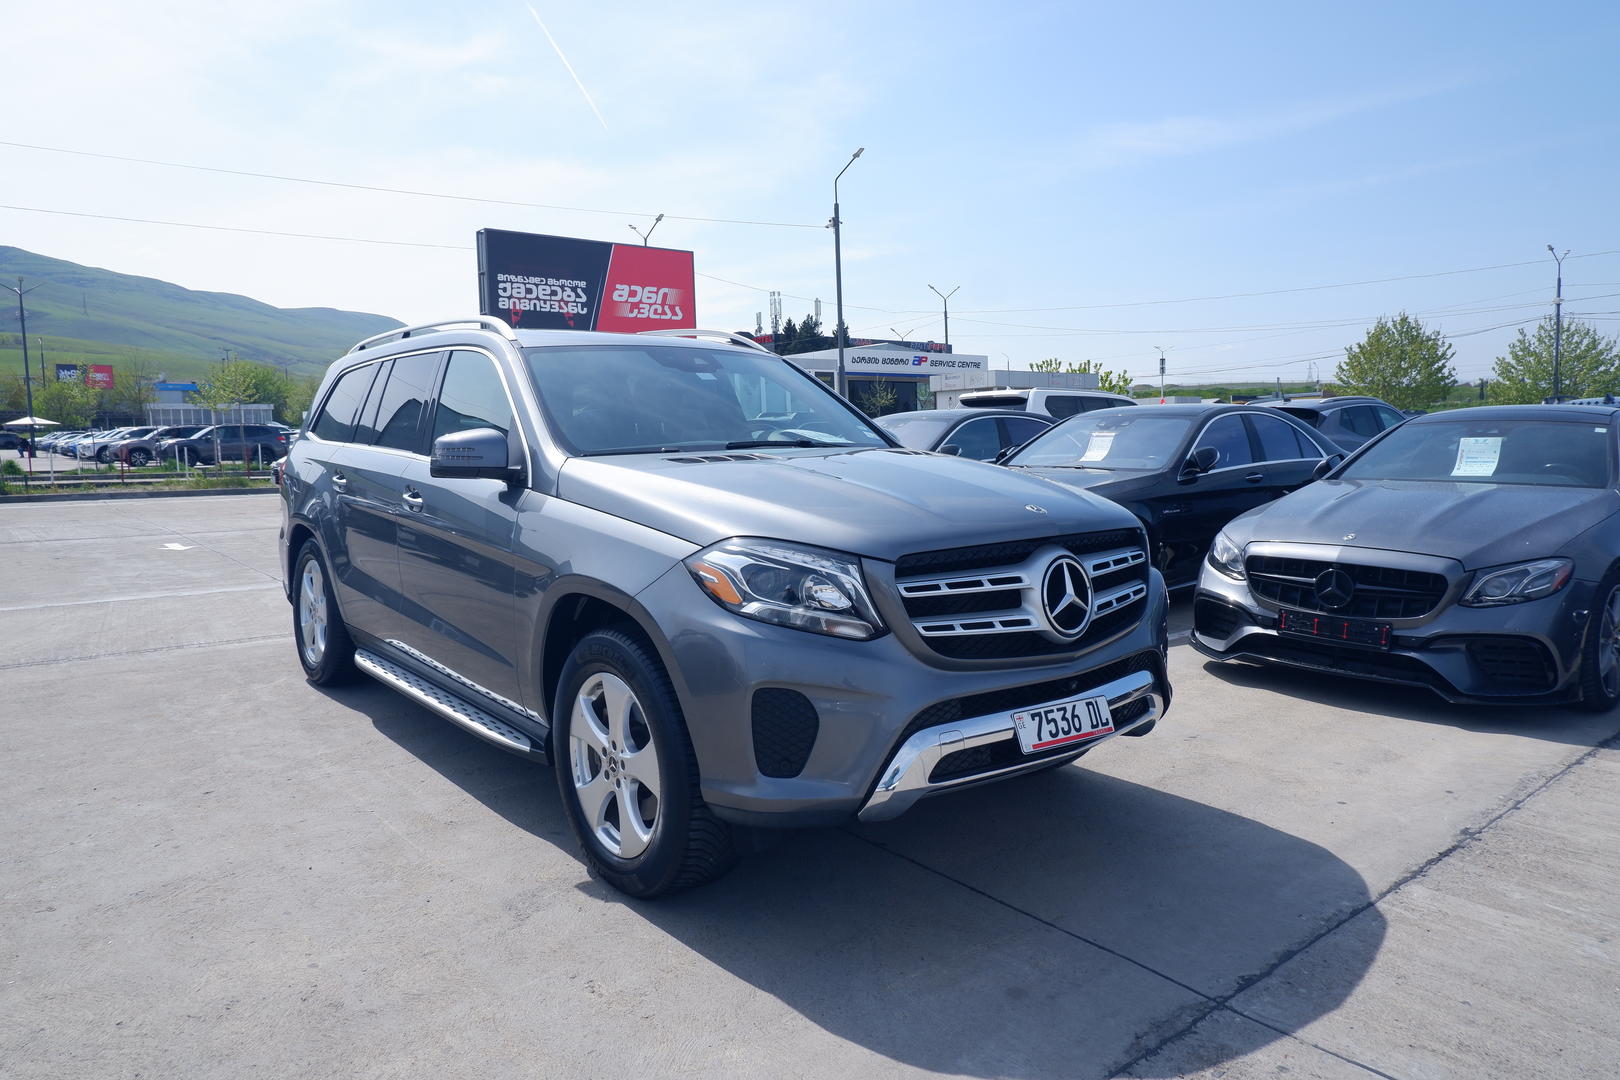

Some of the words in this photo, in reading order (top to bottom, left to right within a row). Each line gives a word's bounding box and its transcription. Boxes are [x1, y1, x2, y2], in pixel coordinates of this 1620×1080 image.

[498, 282, 587, 302] ქმედება
[851, 356, 880, 365] სერვის
[930, 359, 957, 368] SERVICE
[1017, 721, 1026, 730] GE
[1030, 704, 1082, 741] 7536
[1086, 700, 1109, 729] DL
